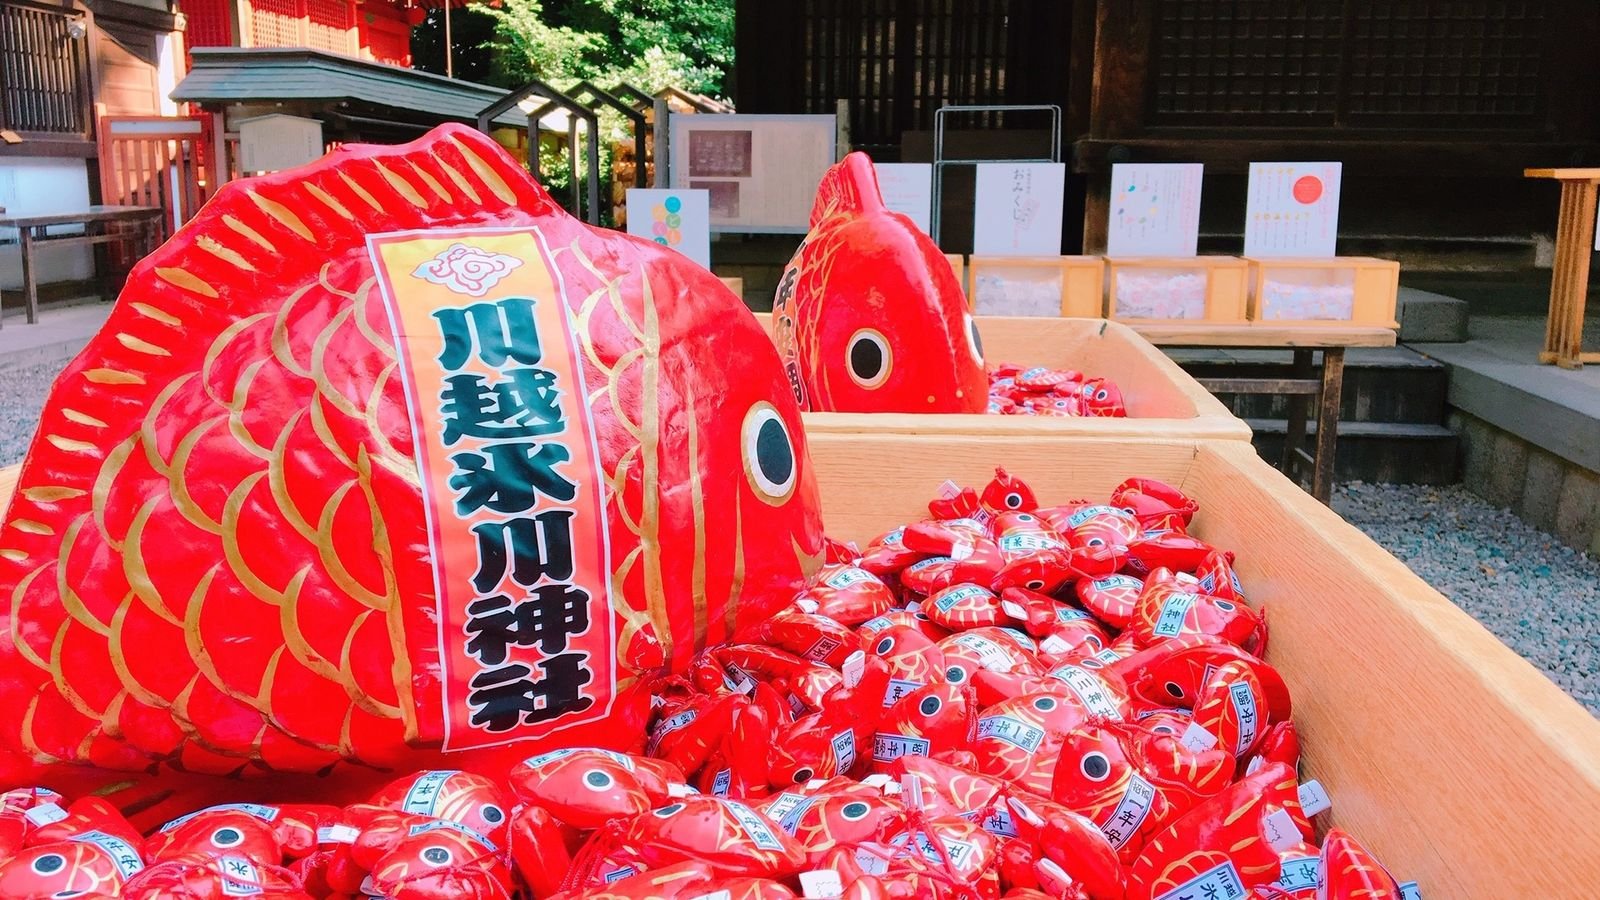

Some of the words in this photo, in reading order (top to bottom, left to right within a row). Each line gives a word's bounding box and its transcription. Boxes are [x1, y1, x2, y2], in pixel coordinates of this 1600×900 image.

[432, 299, 592, 731] 川越氷川神社
[1161, 597, 1186, 633] 川神社
[912, 744, 924, 754] 招
[1217, 870, 1237, 898] 川越
